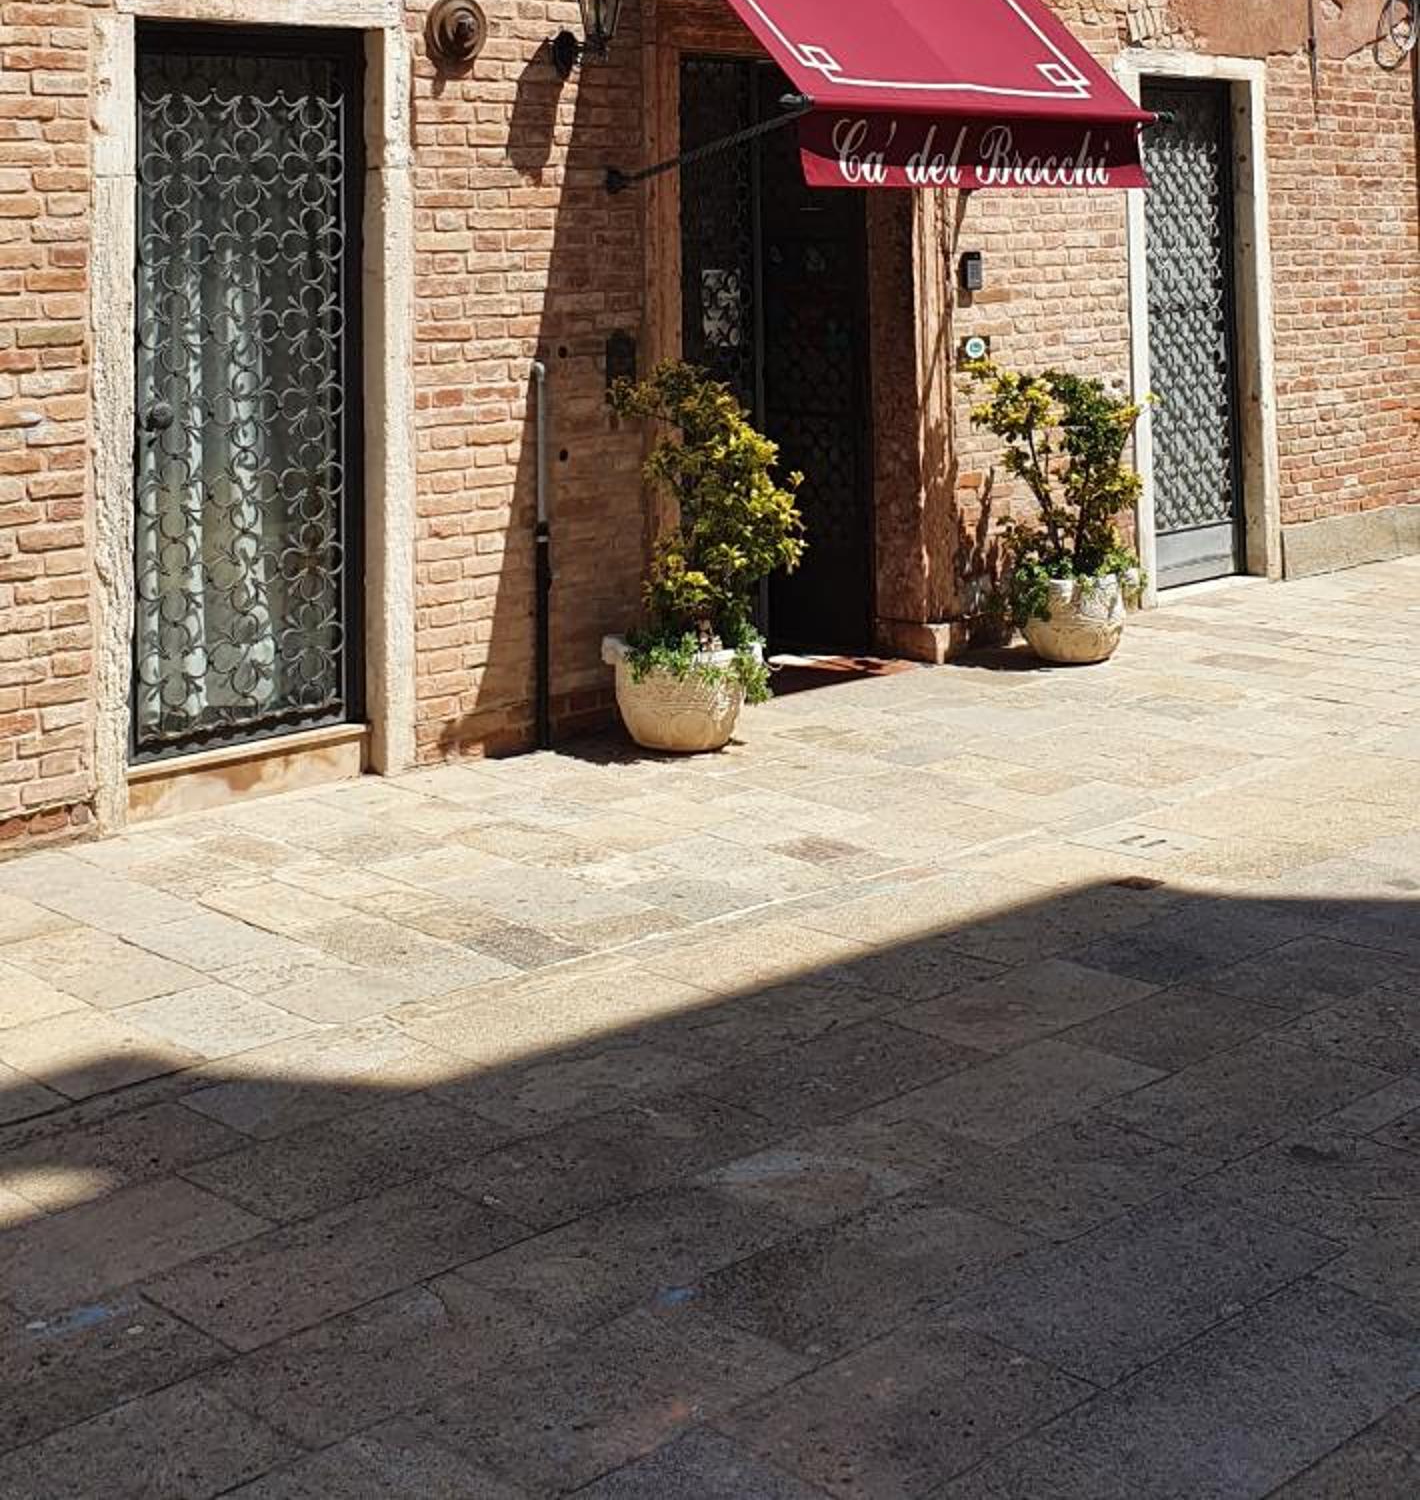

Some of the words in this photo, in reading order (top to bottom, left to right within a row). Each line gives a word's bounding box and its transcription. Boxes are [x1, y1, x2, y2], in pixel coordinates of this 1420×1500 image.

[832, 118, 897, 185] Ca'
[905, 124, 968, 185] del
[976, 125, 1110, 186] Brocchi
